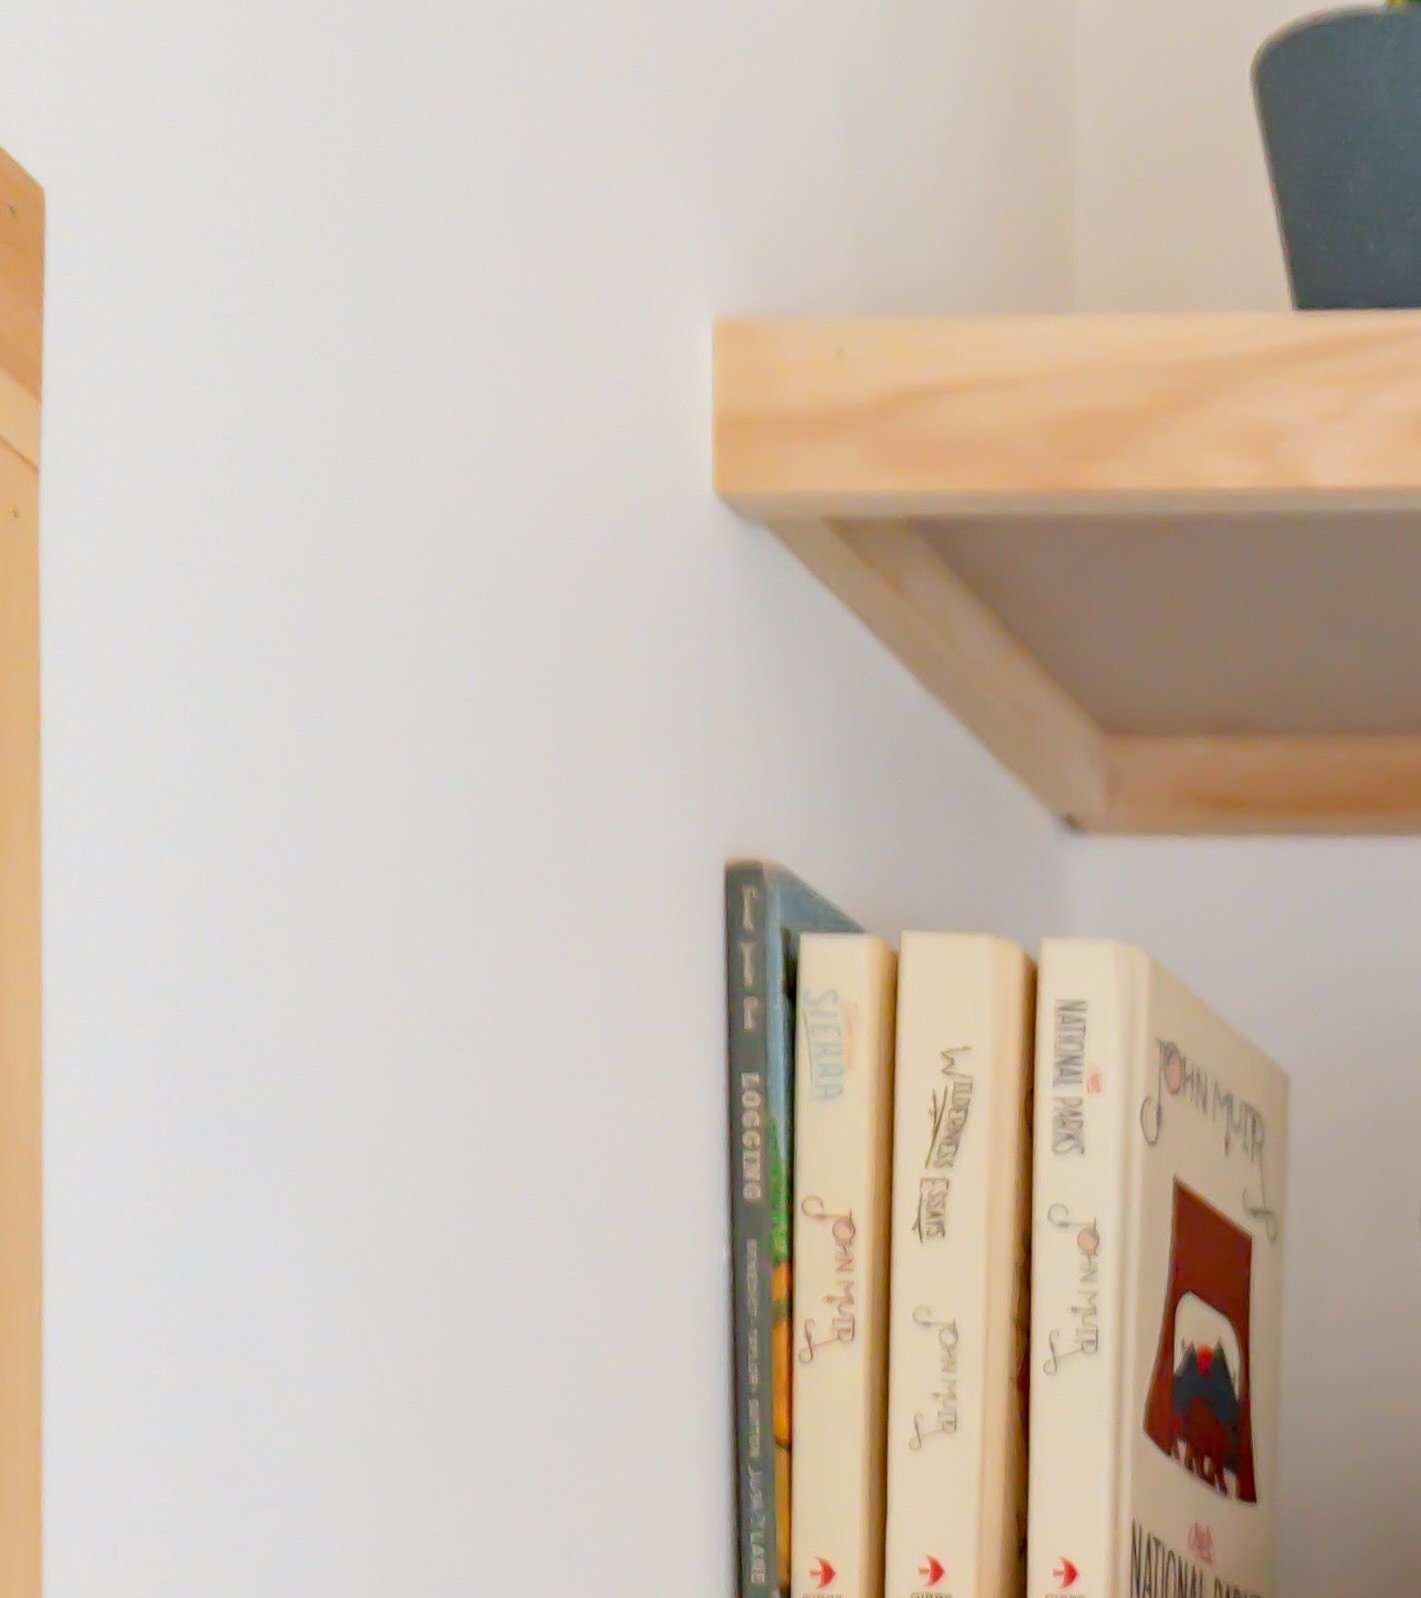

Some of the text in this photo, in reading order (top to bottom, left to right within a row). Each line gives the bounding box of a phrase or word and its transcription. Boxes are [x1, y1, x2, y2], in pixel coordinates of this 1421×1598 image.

[1051, 998, 1087, 1156] NATIONAL PARKS
[1140, 1035, 1278, 1246] JOHN MUIR
